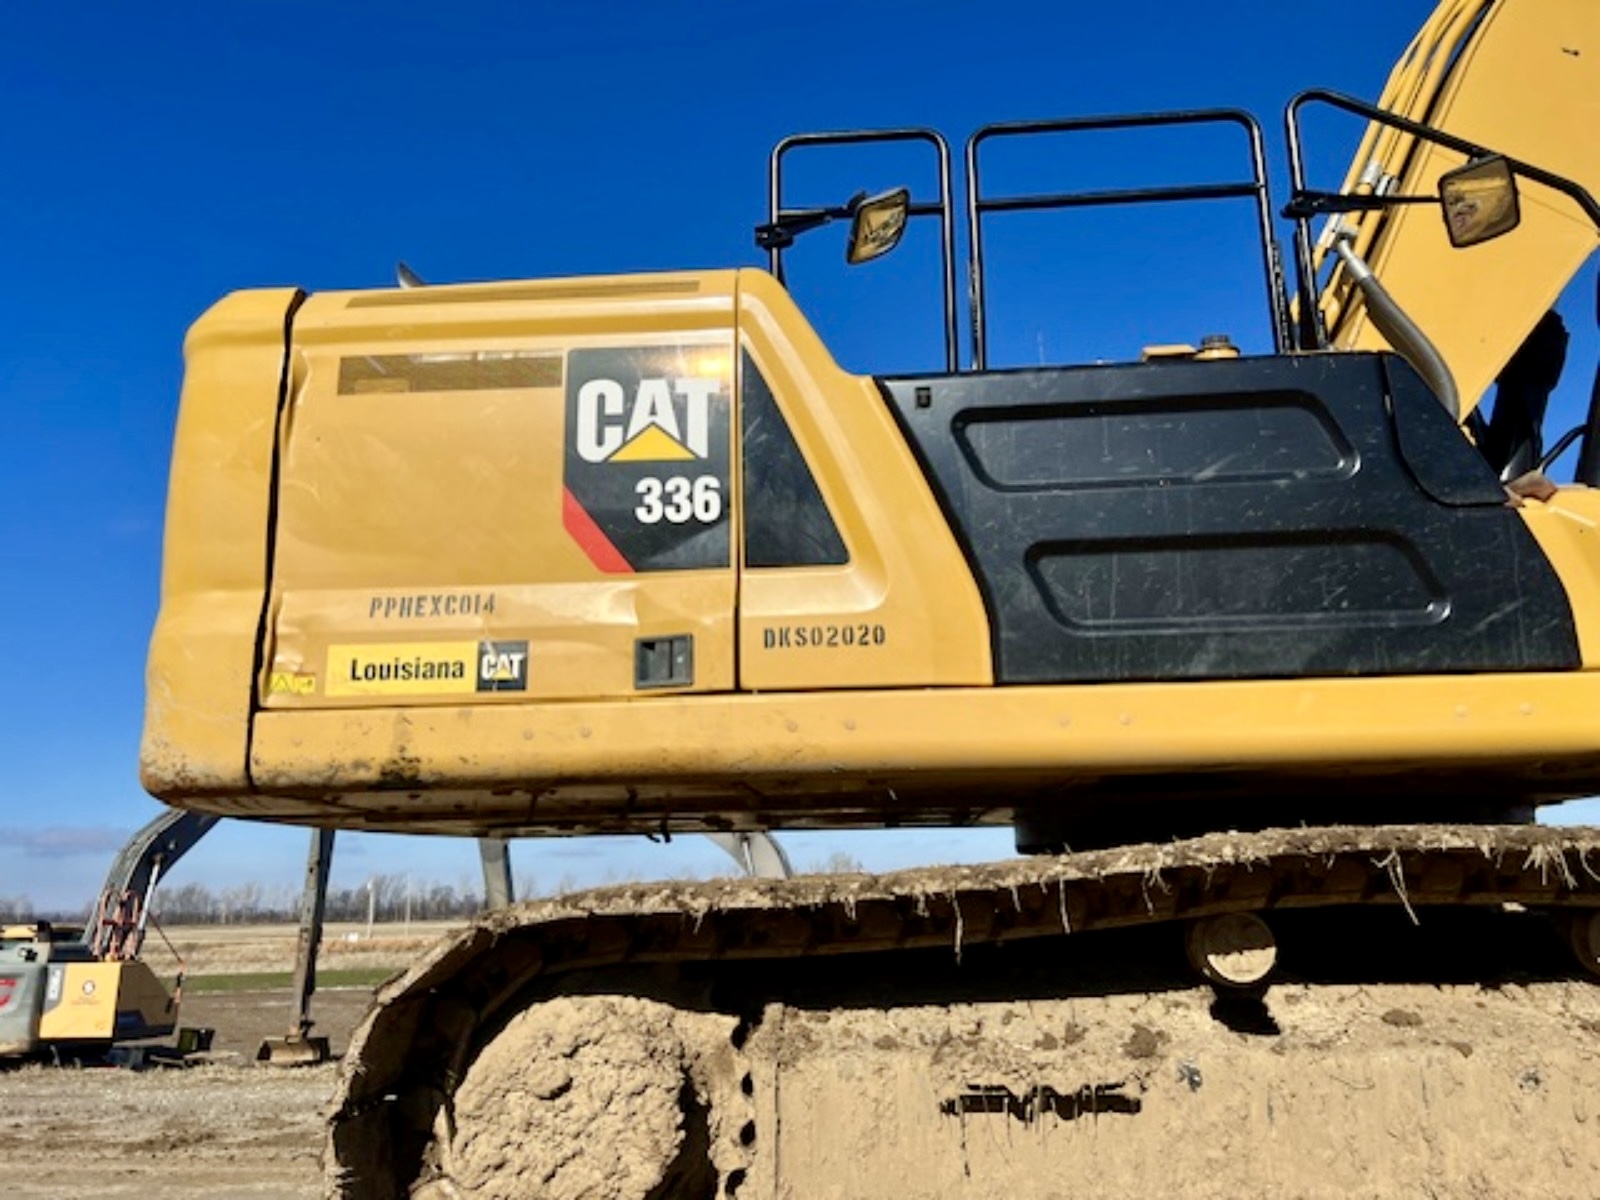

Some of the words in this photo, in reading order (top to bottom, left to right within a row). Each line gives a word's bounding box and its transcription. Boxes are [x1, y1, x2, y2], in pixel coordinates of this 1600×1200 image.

[577, 378, 721, 463] CAT
[634, 476, 721, 523] 336
[764, 624, 886, 649] DKS02020
[351, 657, 465, 681] Louisiana
[481, 652, 524, 681] CAT
